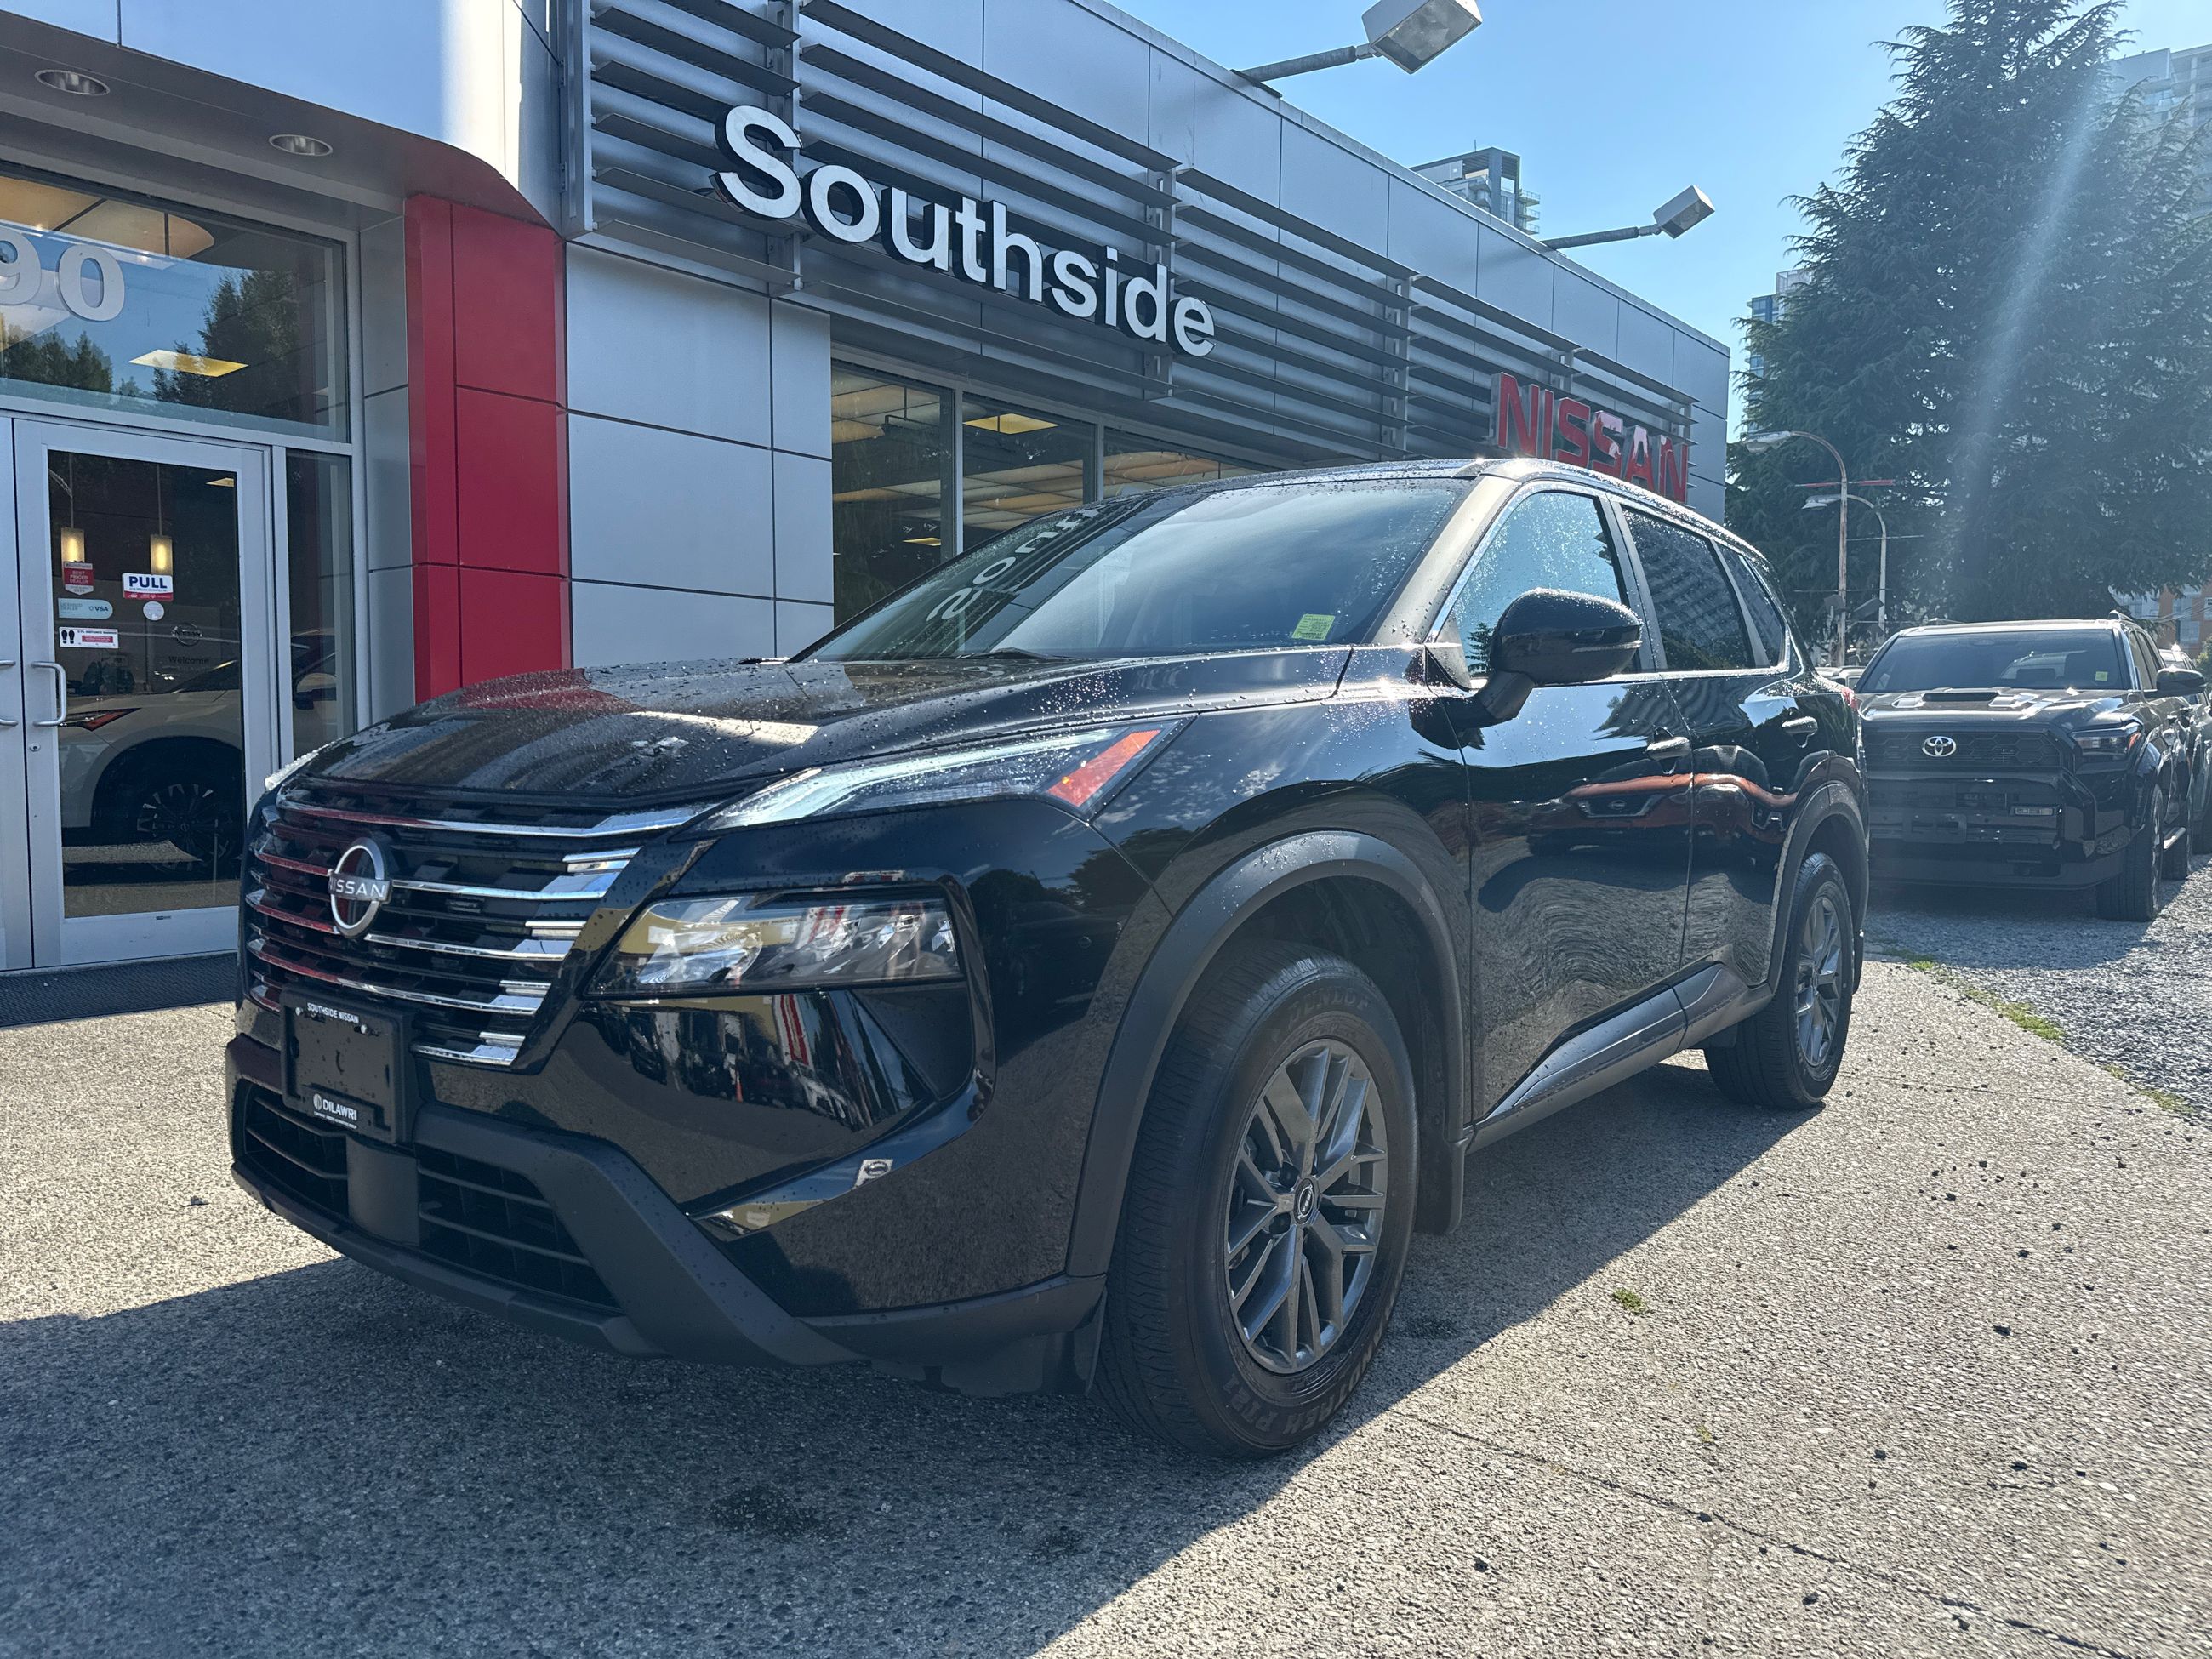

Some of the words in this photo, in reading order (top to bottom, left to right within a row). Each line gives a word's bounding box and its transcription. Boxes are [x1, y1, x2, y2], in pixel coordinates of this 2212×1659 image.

[711, 103, 1217, 357] Southside
[1494, 372, 1689, 504] NISSAN
[128, 576, 168, 589] PULL
[307, 1002, 339, 1018] SOUTHSIDE
[338, 1011, 359, 1023] NISSAN
[322, 1098, 357, 1121] DILAWRI
